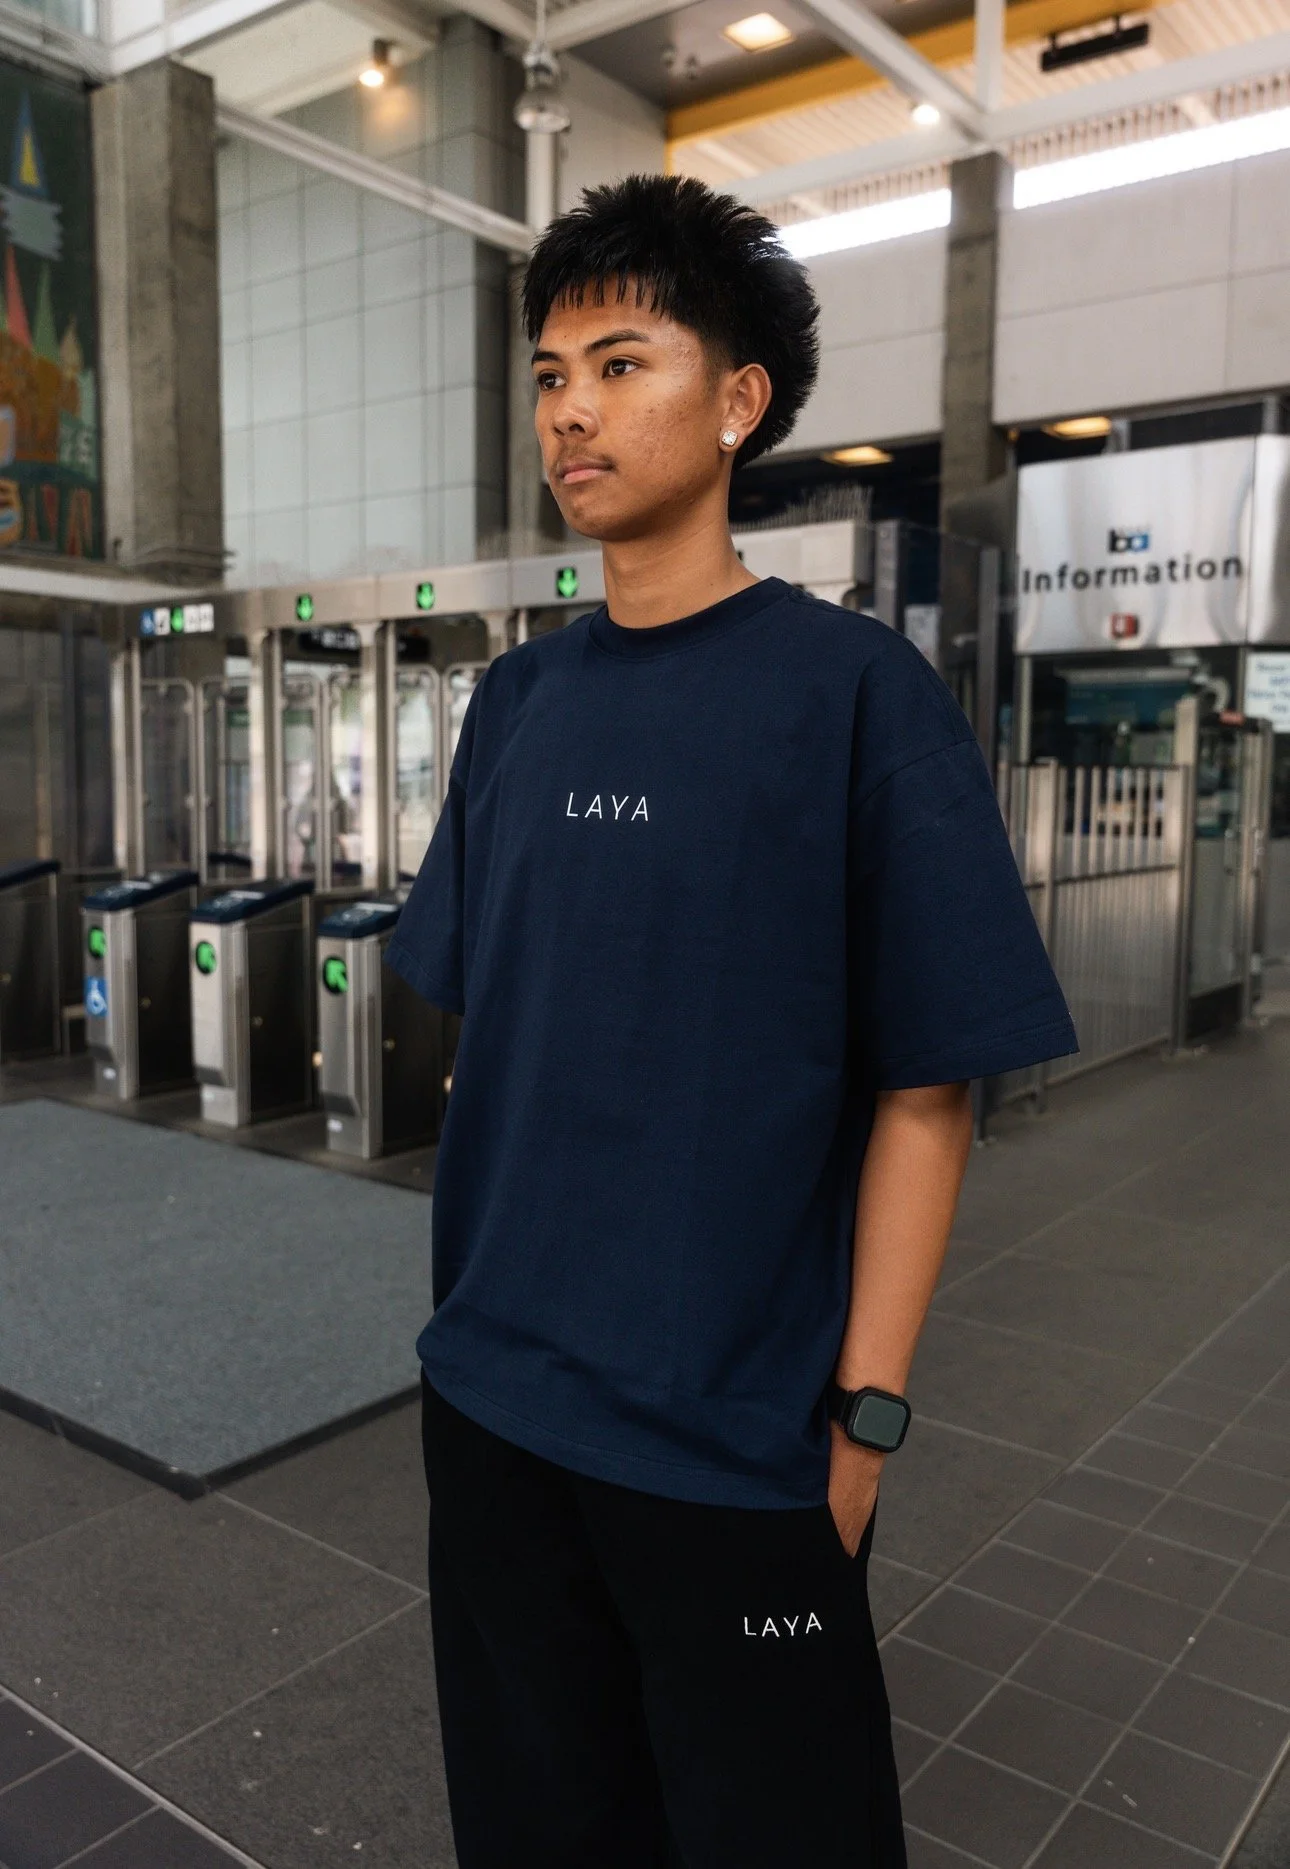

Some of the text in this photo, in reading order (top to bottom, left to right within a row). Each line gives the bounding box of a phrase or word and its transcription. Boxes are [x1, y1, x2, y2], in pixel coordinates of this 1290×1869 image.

[1022, 553, 1244, 594] Information
[566, 791, 649, 822] LAYA
[743, 1611, 823, 1638] LAYA
